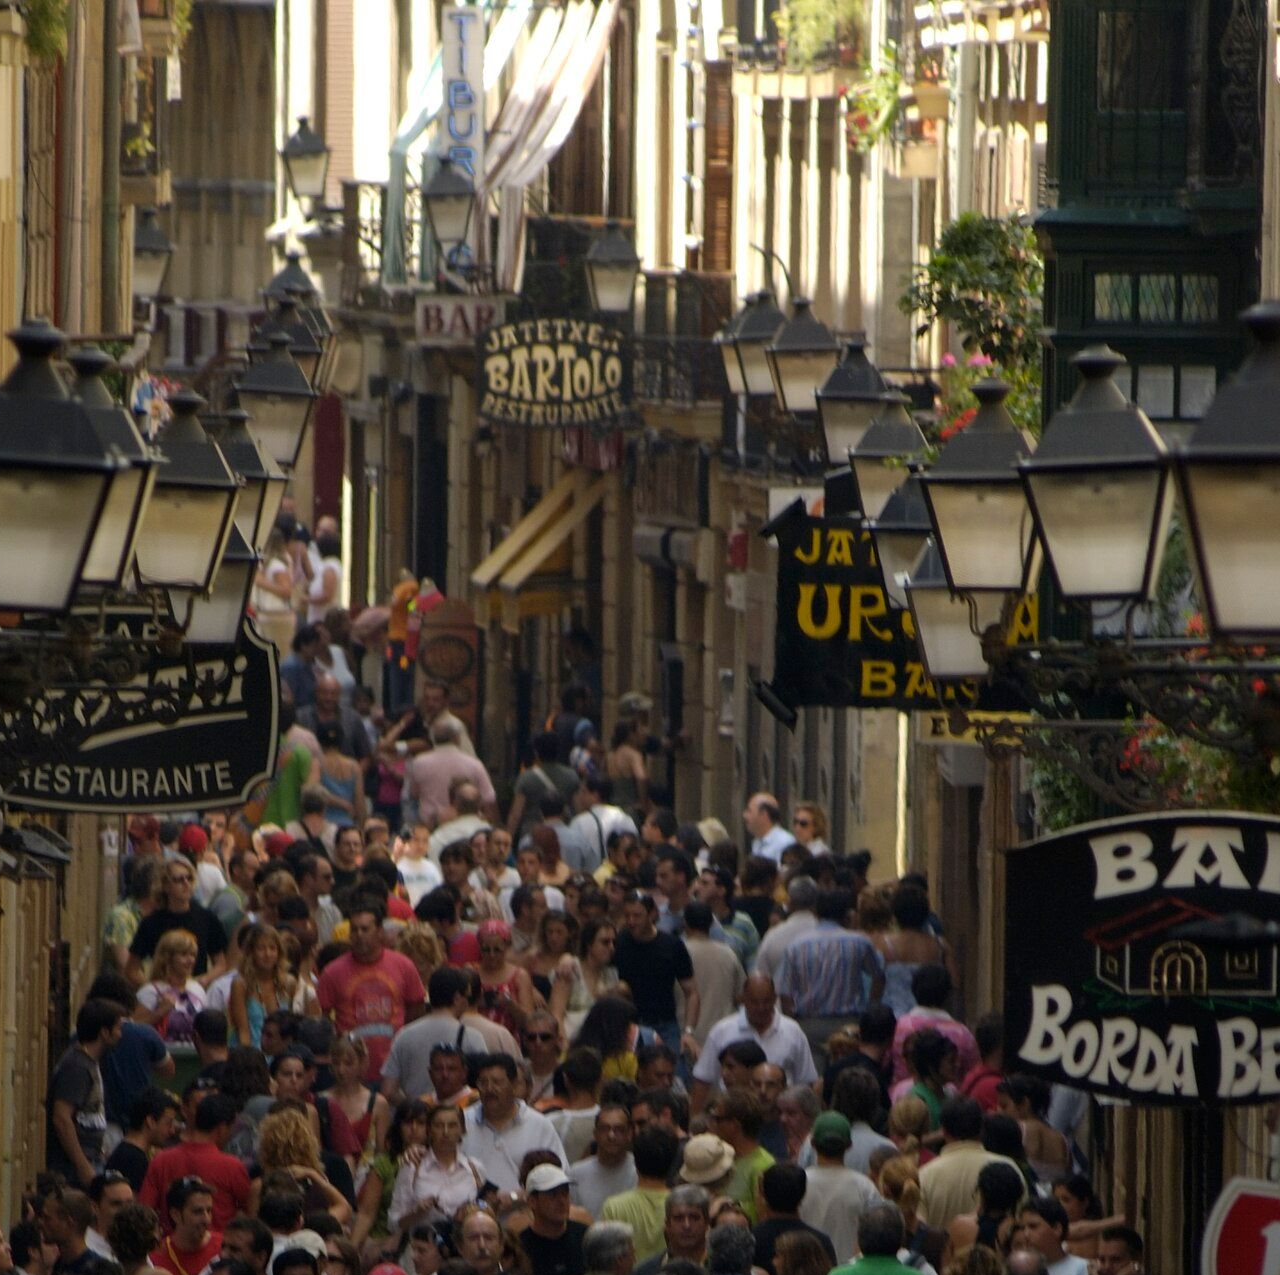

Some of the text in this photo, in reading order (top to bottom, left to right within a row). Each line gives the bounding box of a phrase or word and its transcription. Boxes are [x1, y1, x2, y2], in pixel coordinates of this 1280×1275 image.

[423, 304, 496, 334] BAR
[484, 343, 622, 402] BARTOLO
[1019, 981, 1200, 1097] BORDA
